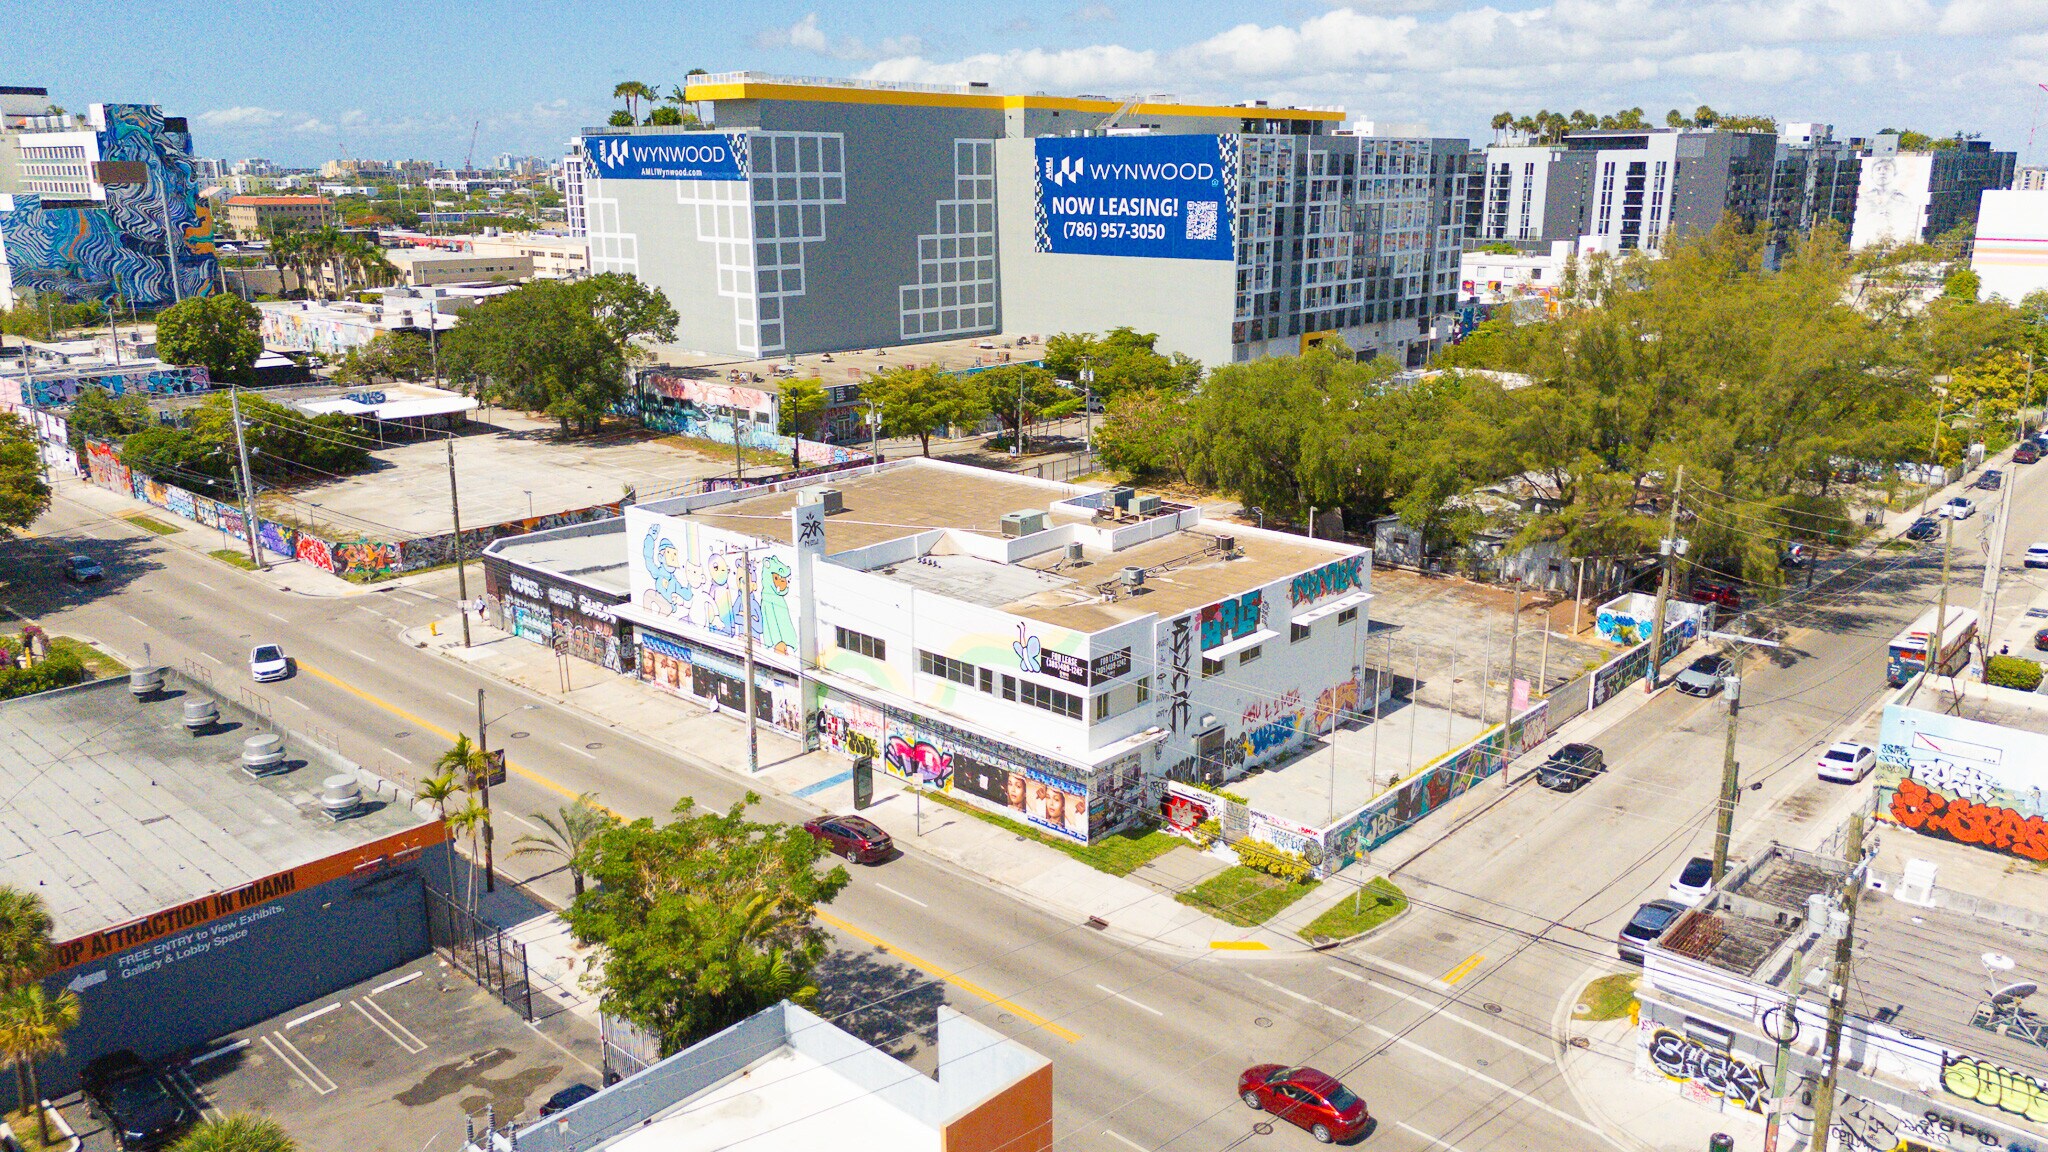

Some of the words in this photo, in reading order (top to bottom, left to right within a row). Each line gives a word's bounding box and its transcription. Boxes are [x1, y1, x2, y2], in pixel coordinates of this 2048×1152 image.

[632, 146, 725, 163] WYNWOOD
[641, 167, 702, 178] AMLIWynwood.com
[1045, 157, 1053, 181] AMLI
[1089, 163, 1214, 181] WYNWOOD
[1052, 197, 1095, 215] NOW
[1099, 197, 1179, 217] LEASING!
[1063, 222, 1098, 240] (786)
[1101, 223, 1166, 240] 957-3050
[1051, 652, 1062, 662] FOR
[1062, 655, 1078, 667] LEASE
[91, 899, 209, 957] ATTRACTION
[215, 892, 234, 916] IN
[239, 871, 296, 906] MIAMI
[118, 949, 151, 968] FREE
[153, 934, 195, 956] ENTRY
[196, 930, 208, 940] to
[210, 920, 237, 936] View
[239, 904, 285, 926] Exhibits,
[121, 958, 163, 979] Gallery
[165, 954, 174, 963] &
[176, 941, 211, 961] Lobby
[213, 928, 248, 949] Space
